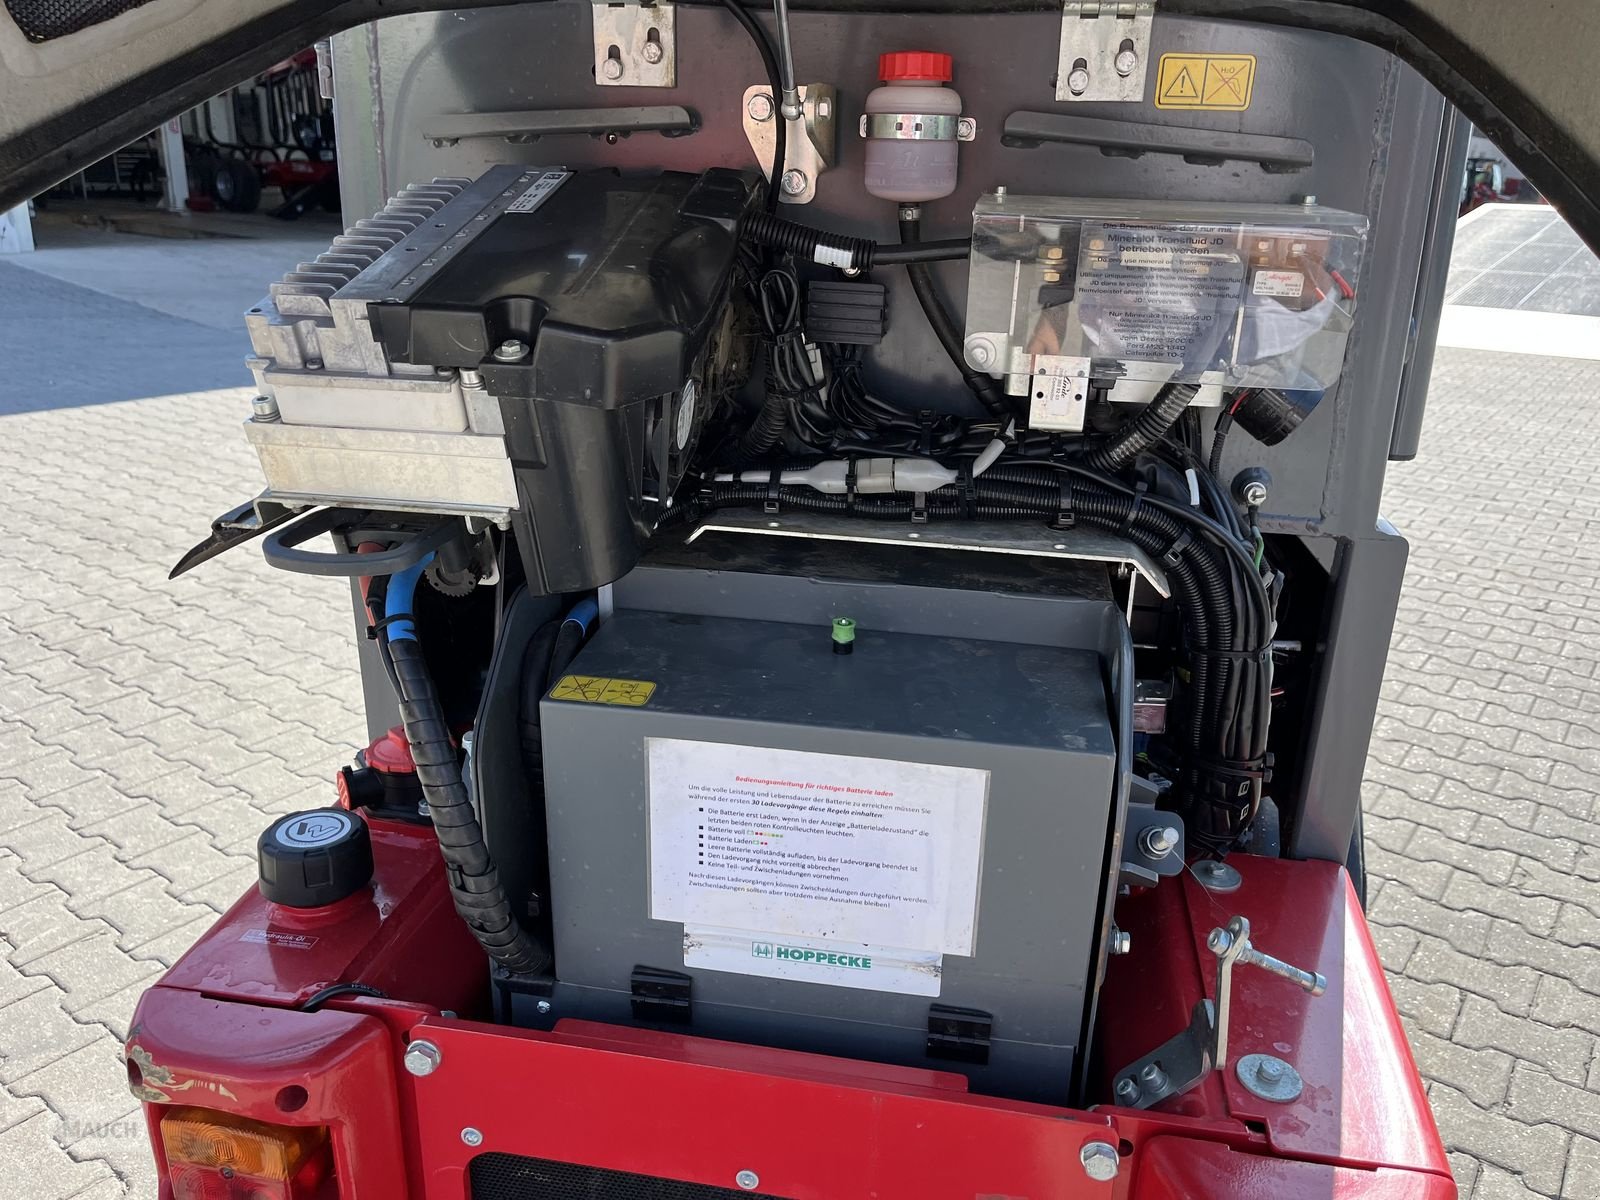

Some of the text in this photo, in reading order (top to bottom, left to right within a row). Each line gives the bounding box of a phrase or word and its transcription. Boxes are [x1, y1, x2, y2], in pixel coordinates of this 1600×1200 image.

[1119, 245, 1210, 254] betrieben werden
[1158, 235, 1207, 245] Transfluid
[1210, 238, 1224, 246] JD
[736, 776, 804, 789] Bedienungsanleitung
[816, 784, 846, 792] richtiges
[846, 787, 872, 795] Batterie
[688, 793, 716, 802] während
[761, 801, 808, 810] Ladevorgänge
[826, 807, 850, 815] Regeln
[728, 788, 756, 797] Leistung
[770, 792, 812, 801] Lebensdauer
[826, 798, 851, 806] Batterie
[862, 802, 892, 810] erreichen
[894, 804, 920, 813] müssen
[708, 817, 730, 825] letzten
[826, 828, 855, 838] leuchten.
[720, 808, 744, 817] Batterie
[760, 813, 779, 821] Laden,
[820, 820, 846, 828] Anzeige
[708, 826, 732, 834] Batterie
[708, 835, 732, 843] Batterie
[722, 854, 761, 864] Ladevorgang
[778, 860, 806, 869] vorzeitig
[806, 862, 840, 872] abbrechen
[726, 846, 752, 854] Batterie
[752, 848, 786, 858] vollständig
[786, 852, 816, 862] aufladen,
[840, 858, 880, 868] Ladevorgang
[882, 862, 908, 871] beendet
[754, 866, 812, 878] Zwischenladungen
[812, 874, 848, 882] vornehmen
[688, 880, 746, 892] Zwischenladungen
[746, 886, 768, 894] sollten
[784, 892, 814, 900] trotzdem
[830, 896, 862, 905] Ausnahme
[864, 900, 890, 908] bleiben!
[727, 875, 774, 886] Ladevorgängen
[776, 880, 798, 889] können
[800, 884, 858, 896] Zwischenladungen
[860, 890, 902, 901] durchgeführt
[776, 946, 872, 968] HOPPECKE
